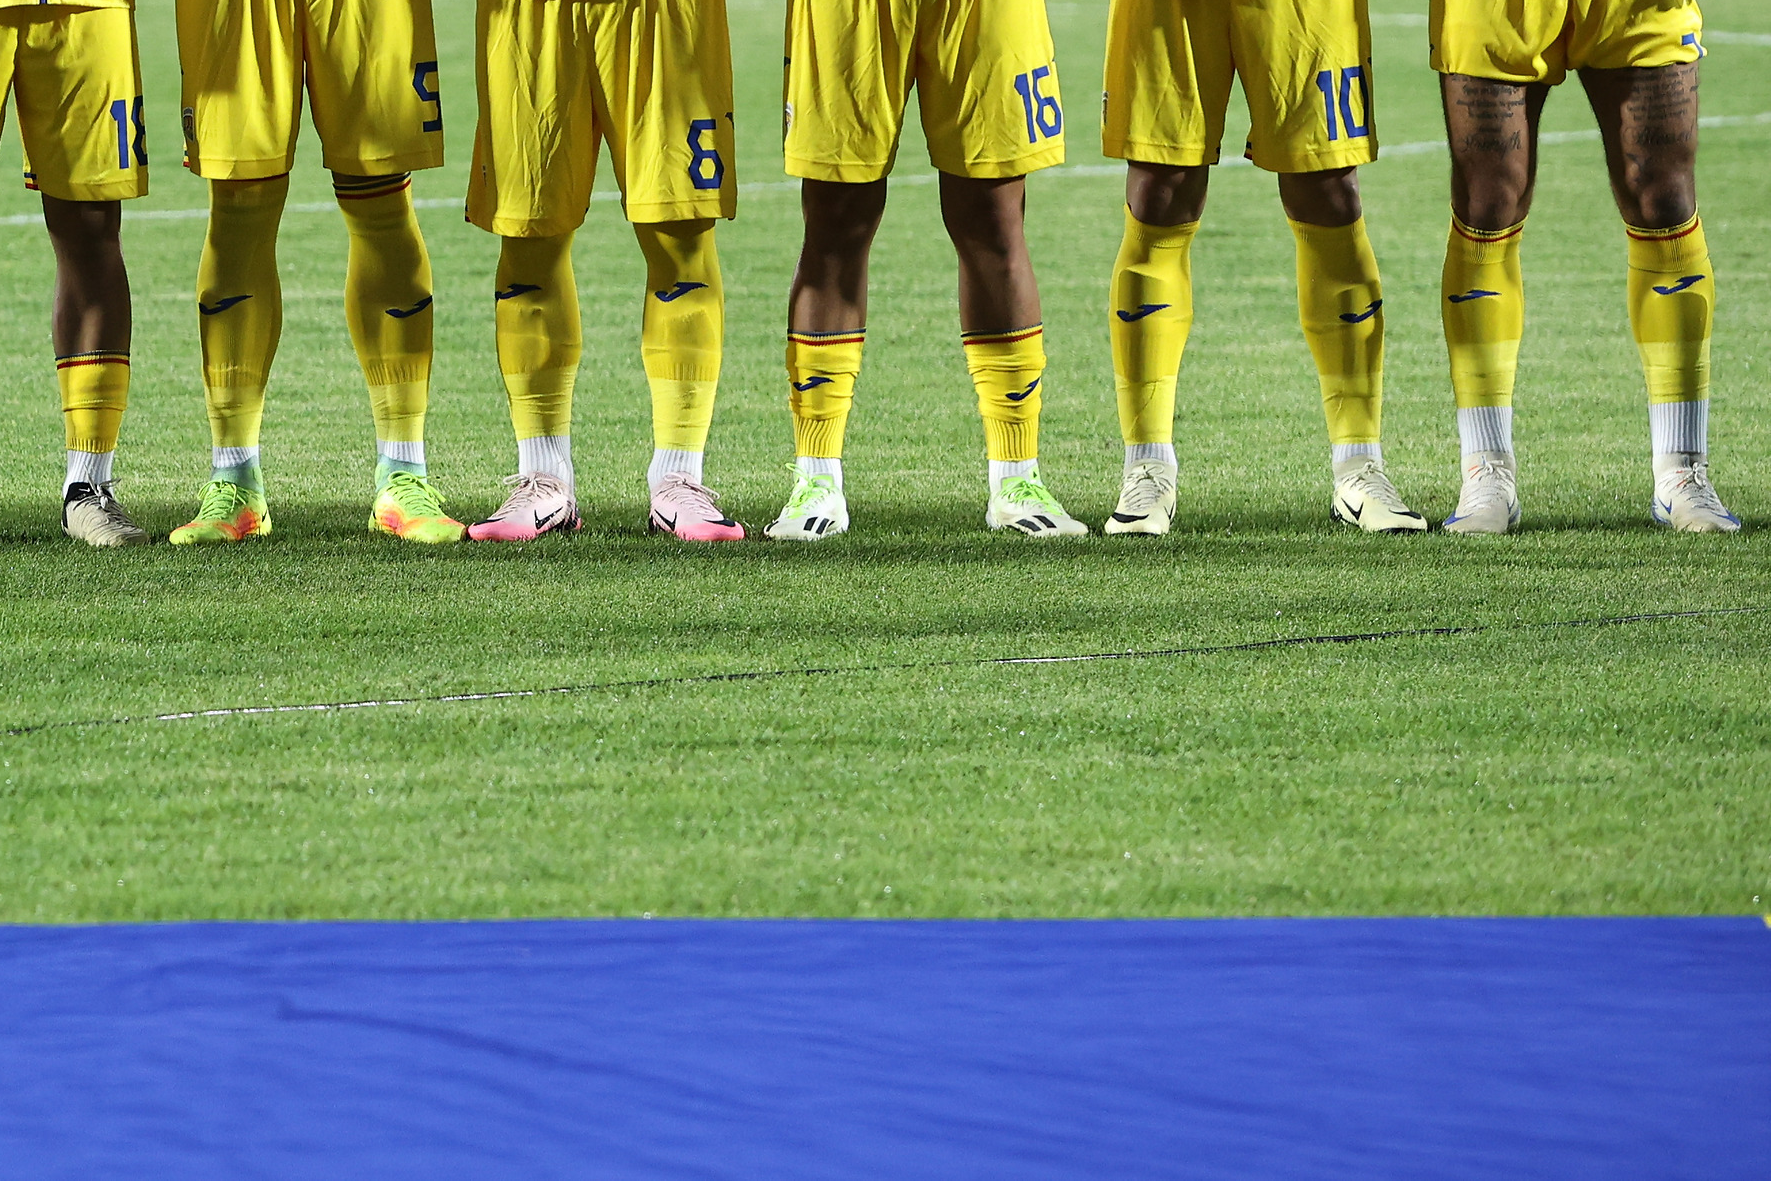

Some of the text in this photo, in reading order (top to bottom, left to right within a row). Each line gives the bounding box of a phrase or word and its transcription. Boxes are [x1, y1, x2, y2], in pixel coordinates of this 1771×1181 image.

[1014, 65, 1062, 144] 16
[1316, 65, 1370, 141] 10
[687, 119, 724, 190] 6
